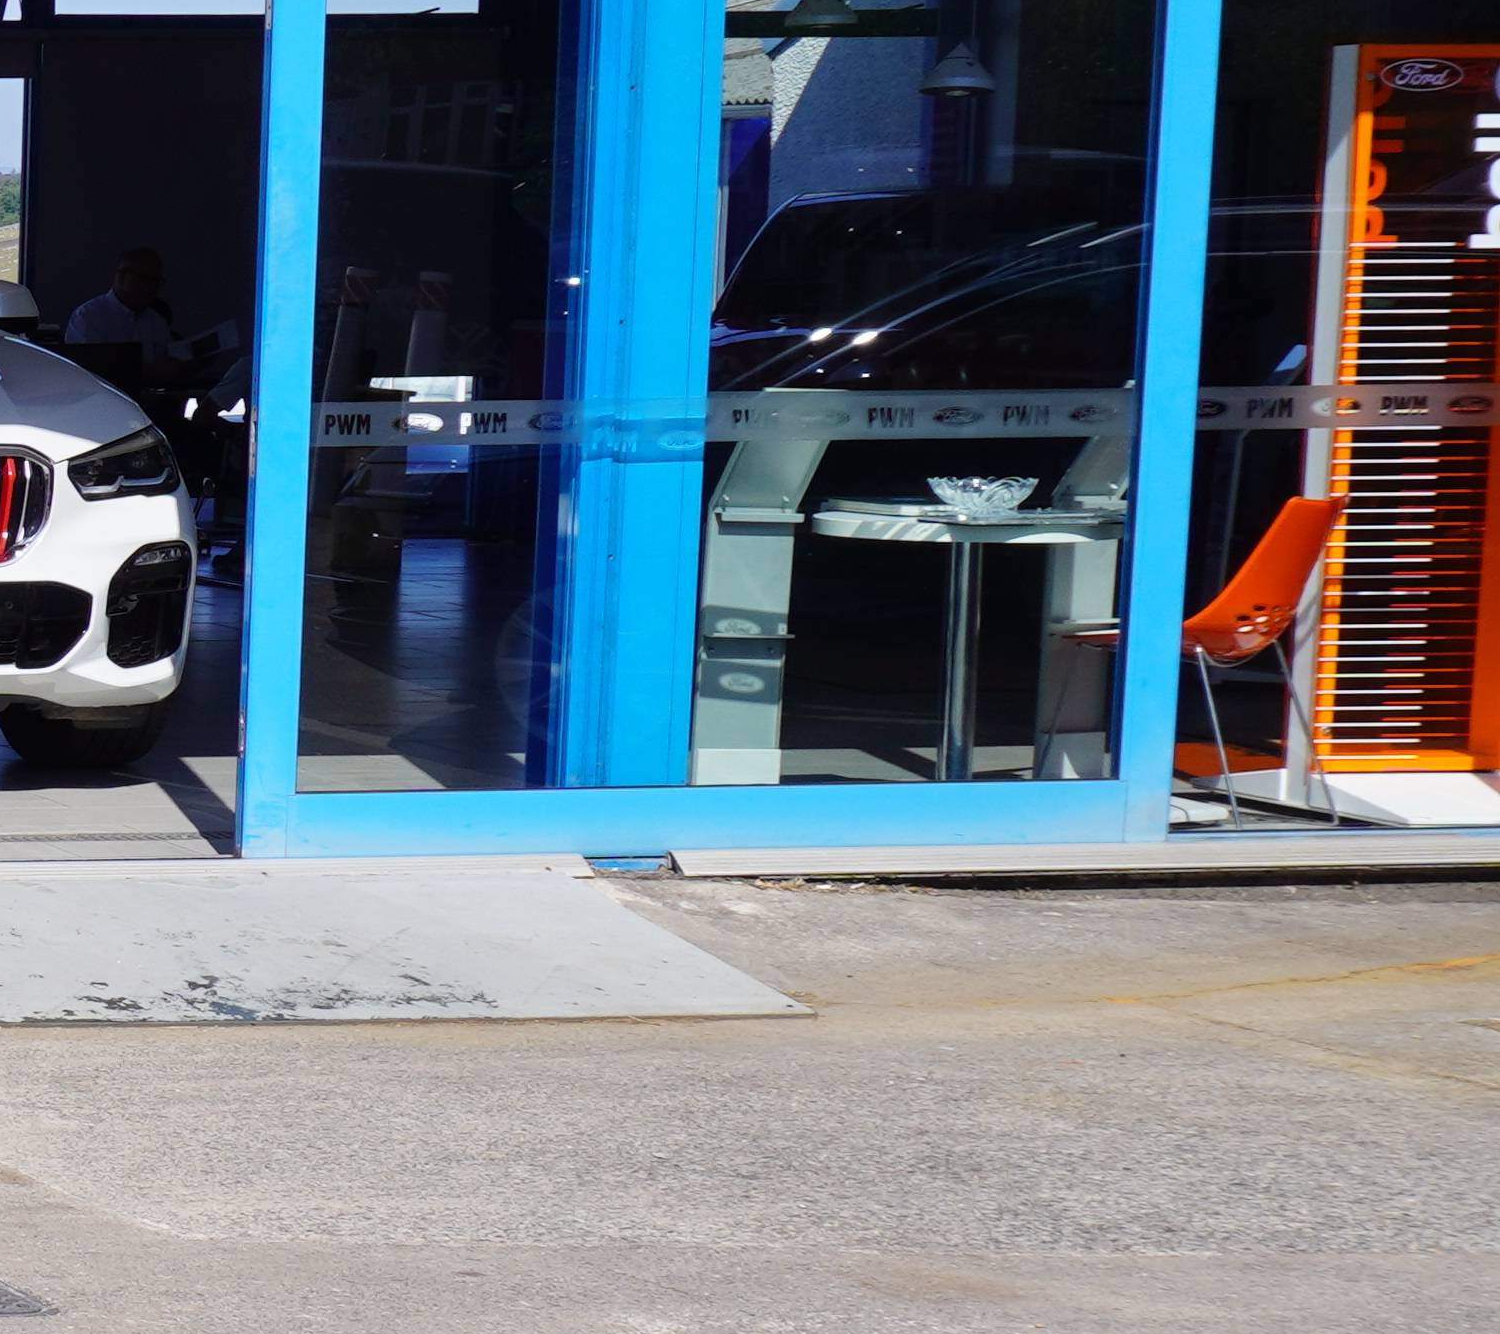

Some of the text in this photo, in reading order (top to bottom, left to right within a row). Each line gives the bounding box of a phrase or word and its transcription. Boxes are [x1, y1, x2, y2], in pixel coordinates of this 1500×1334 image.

[1394, 61, 1450, 86] Ford
[324, 414, 371, 435] PWM
[460, 412, 507, 434] PWM
[868, 407, 915, 428] PWM
[1003, 405, 1049, 426] PWM
